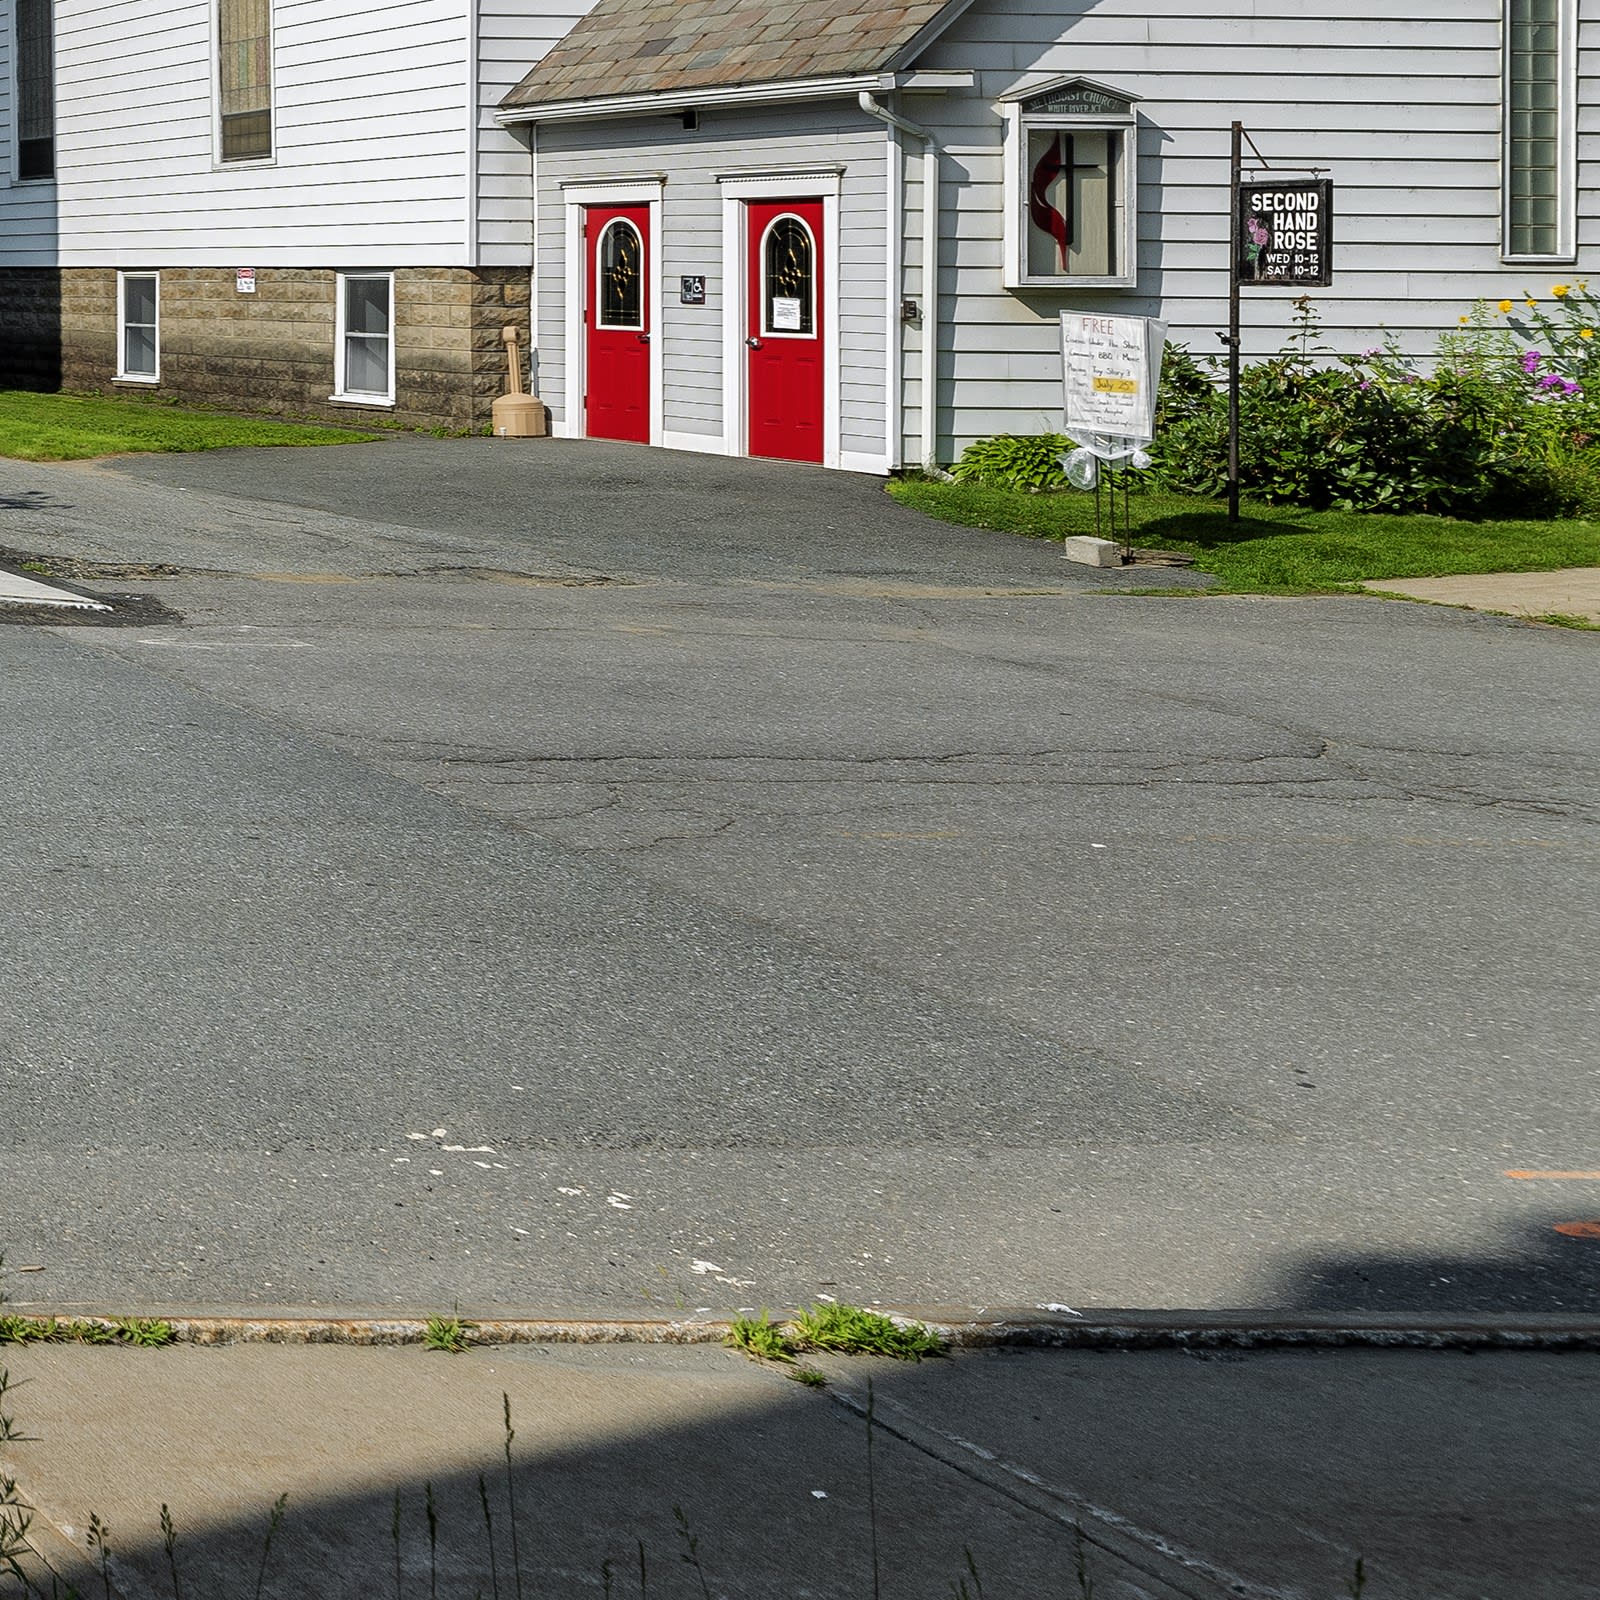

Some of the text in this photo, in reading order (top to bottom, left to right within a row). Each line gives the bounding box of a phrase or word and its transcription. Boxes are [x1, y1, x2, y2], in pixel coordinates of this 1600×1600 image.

[1047, 104, 1068, 113] WHITE
[1069, 104, 1089, 113] RIVER
[1251, 192, 1319, 211] SECOND
[1273, 212, 1317, 231] HAND
[1273, 231, 1318, 250] ROSE
[1266, 253, 1319, 264] WED 10-12
[1267, 265, 1319, 276] SAT 10-12
[1082, 317, 1114, 336] FREE
[1092, 365, 1103, 376] Toy
[1106, 367, 1124, 379] Story
[1096, 378, 1114, 391] July
